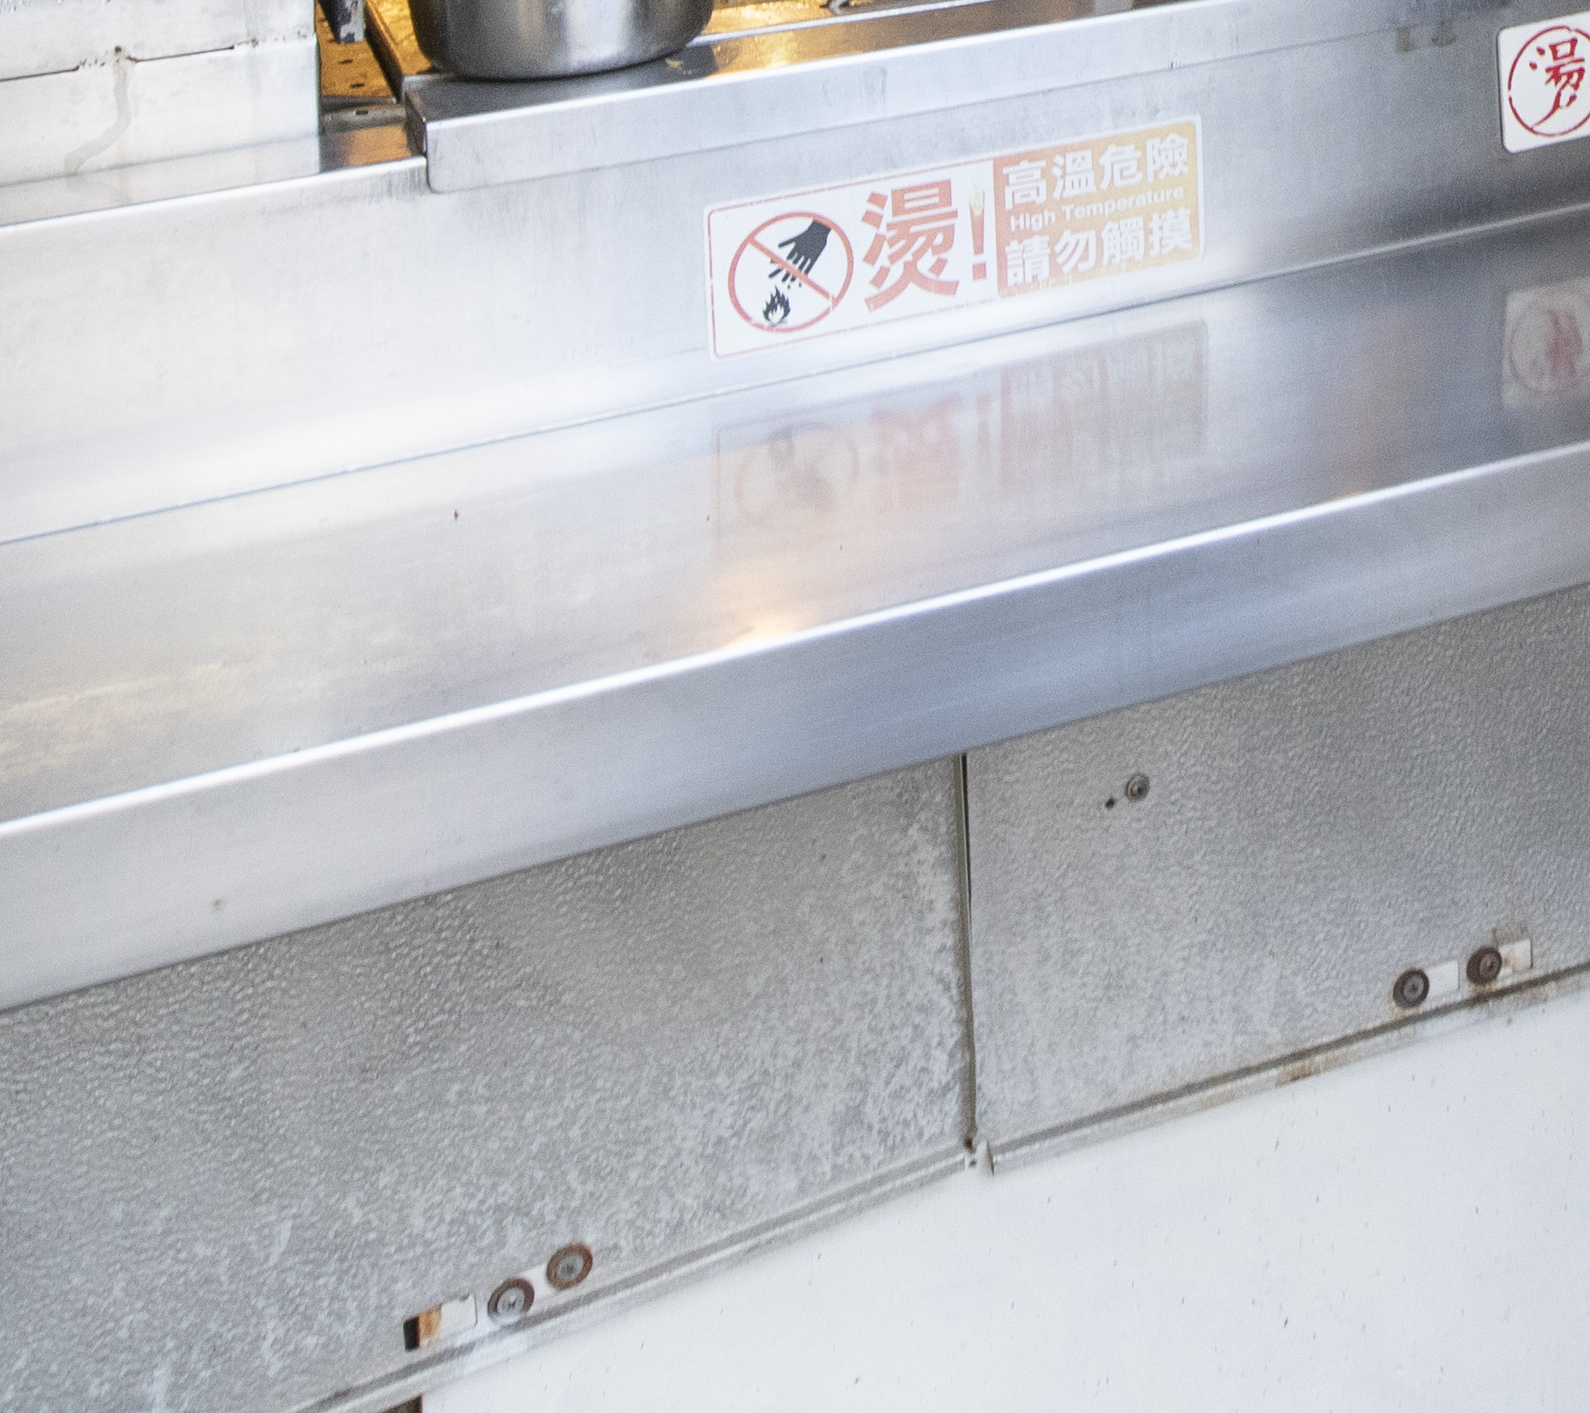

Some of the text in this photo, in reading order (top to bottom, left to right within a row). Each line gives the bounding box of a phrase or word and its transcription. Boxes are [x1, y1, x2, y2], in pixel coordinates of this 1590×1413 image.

[1003, 132, 1189, 210] 高溫危險
[1010, 186, 1185, 233] High Temperature
[1004, 206, 1192, 287] 請勿觸摸
